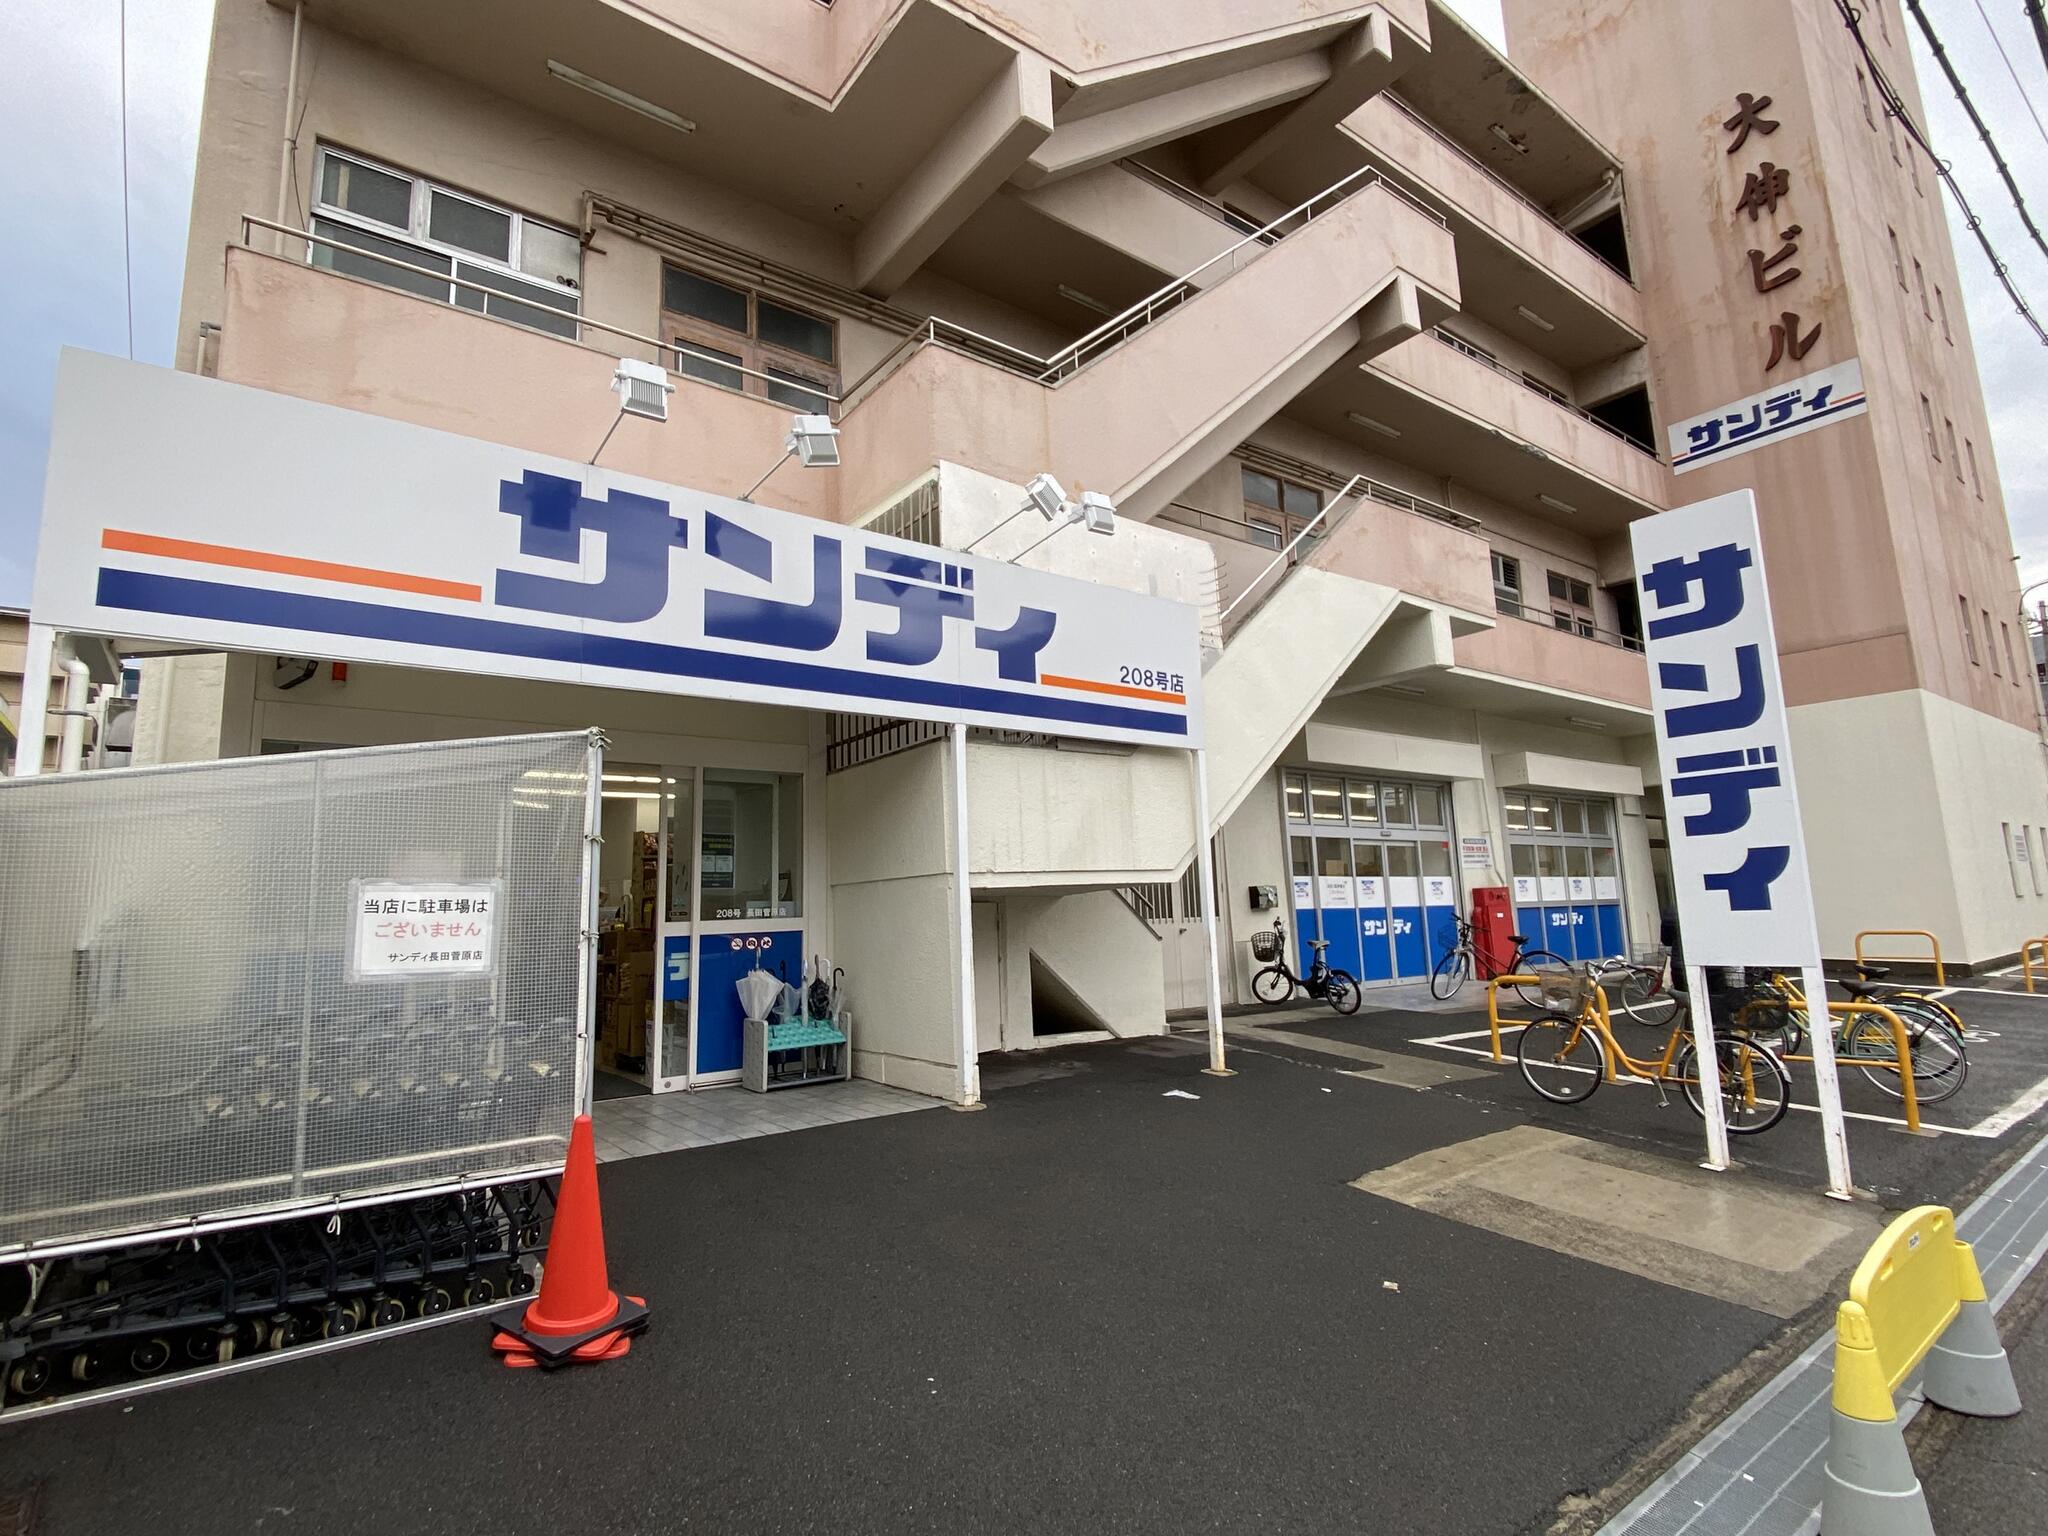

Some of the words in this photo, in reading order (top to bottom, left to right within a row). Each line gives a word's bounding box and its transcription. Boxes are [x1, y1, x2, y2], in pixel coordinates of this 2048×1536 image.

[1722, 92, 1822, 371] 大伸ビル
[1688, 384, 1833, 453] サンディ
[494, 469, 1057, 684] サンディ
[1119, 665, 1185, 694] 208号店
[1642, 543, 1791, 911] サンディ
[364, 899, 489, 914] 当店に駐車場は
[716, 908, 742, 918] 208号
[375, 921, 482, 938] ございません
[387, 950, 483, 963] サンディ長田菅原店
